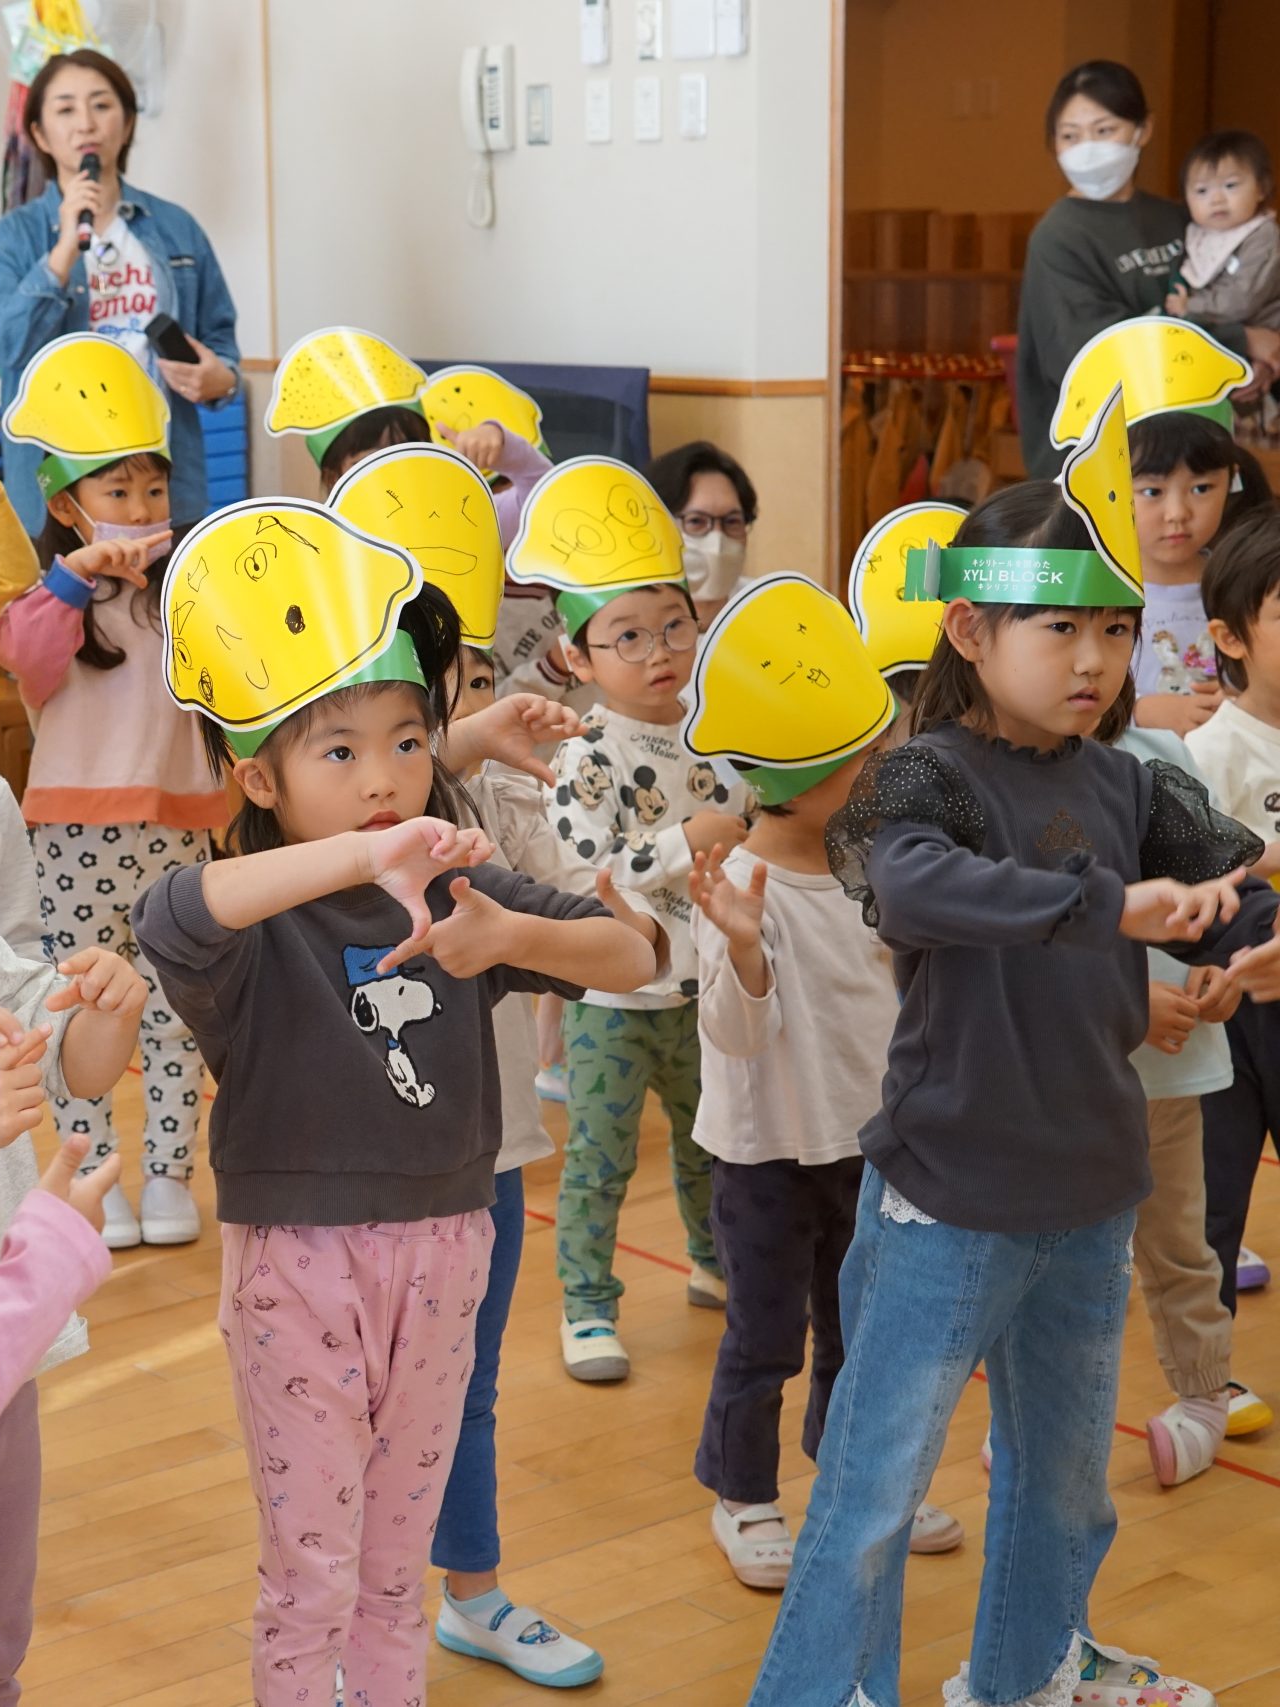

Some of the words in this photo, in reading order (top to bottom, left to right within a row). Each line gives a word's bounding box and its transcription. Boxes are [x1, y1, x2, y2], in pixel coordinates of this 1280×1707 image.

[963, 569, 993, 582] XYLI
[998, 570, 1064, 584] BLOCK
[513, 628, 543, 659] THE
